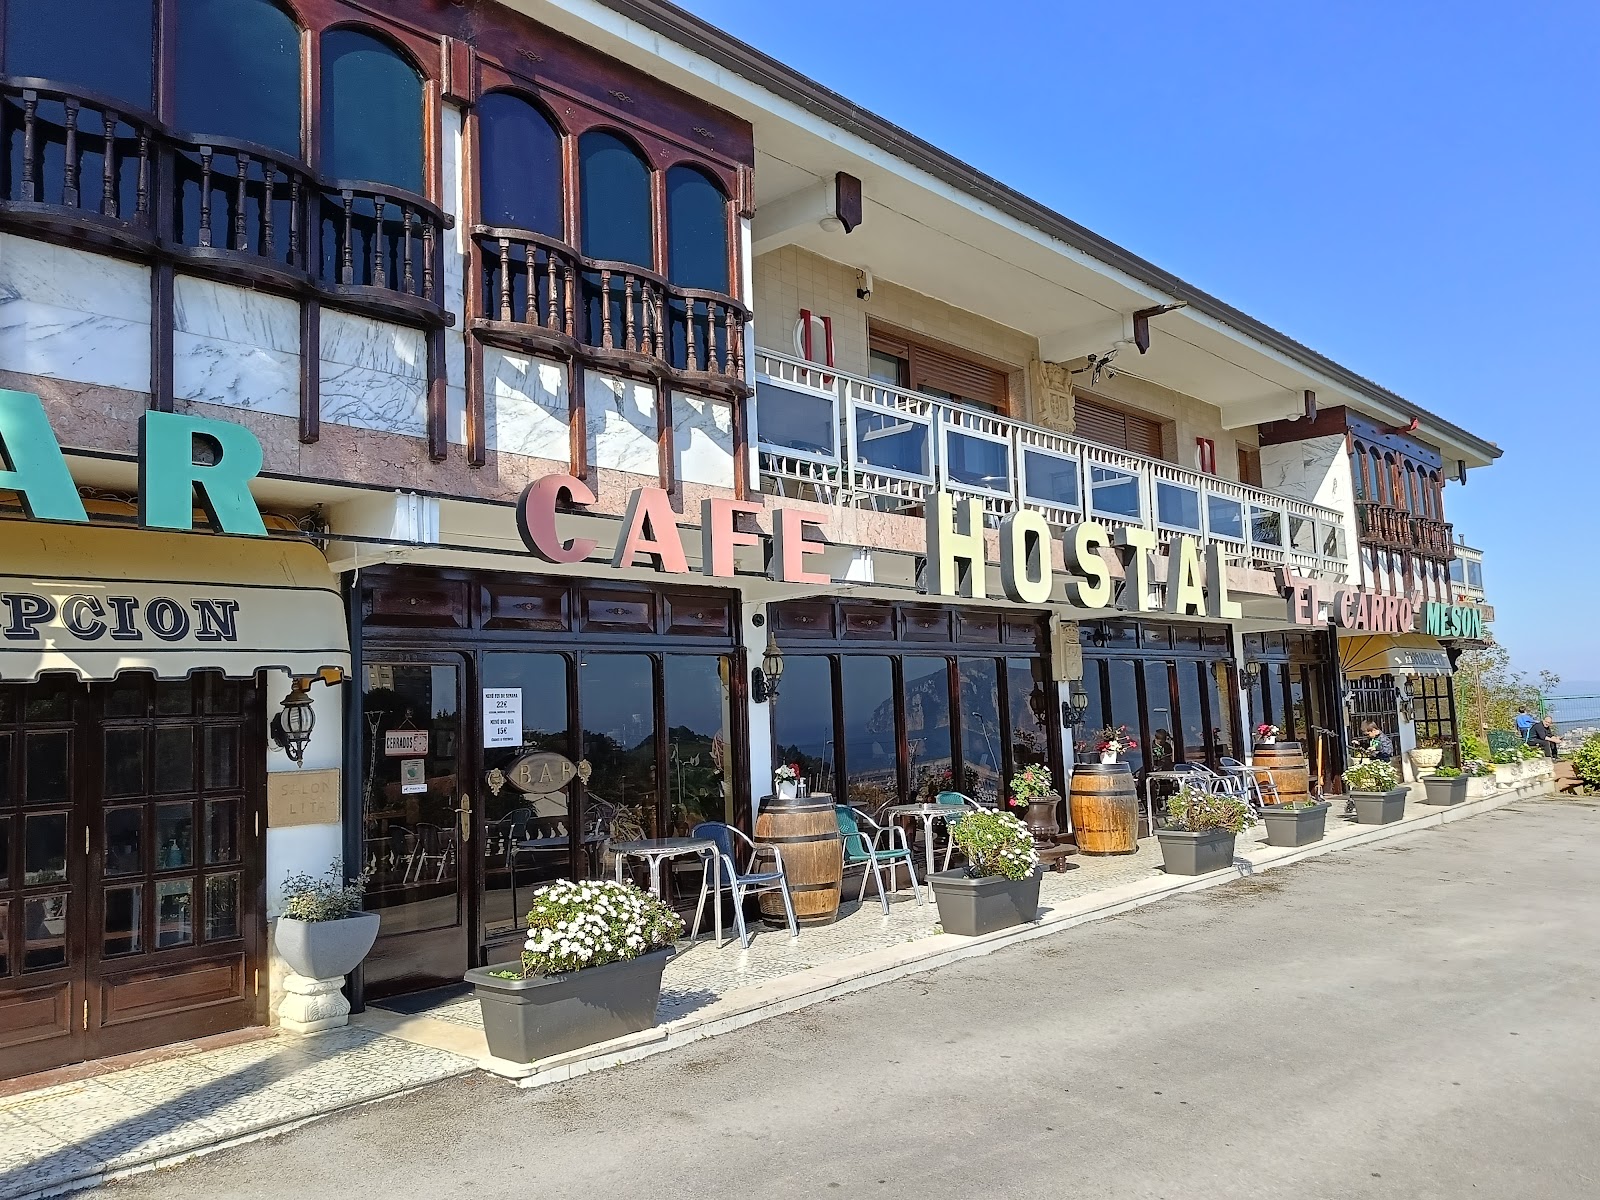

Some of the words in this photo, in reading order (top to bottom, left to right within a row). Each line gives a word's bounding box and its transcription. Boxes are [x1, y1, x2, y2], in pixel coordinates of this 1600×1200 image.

[516, 473, 831, 585] CAFE
[926, 492, 1243, 619] HOSTAL
[0, 592, 240, 641] PCION
[1421, 602, 1482, 638] MESON
[386, 736, 413, 749] CERRADOS
[497, 727, 508, 735] 15€
[520, 762, 572, 784] BAR
